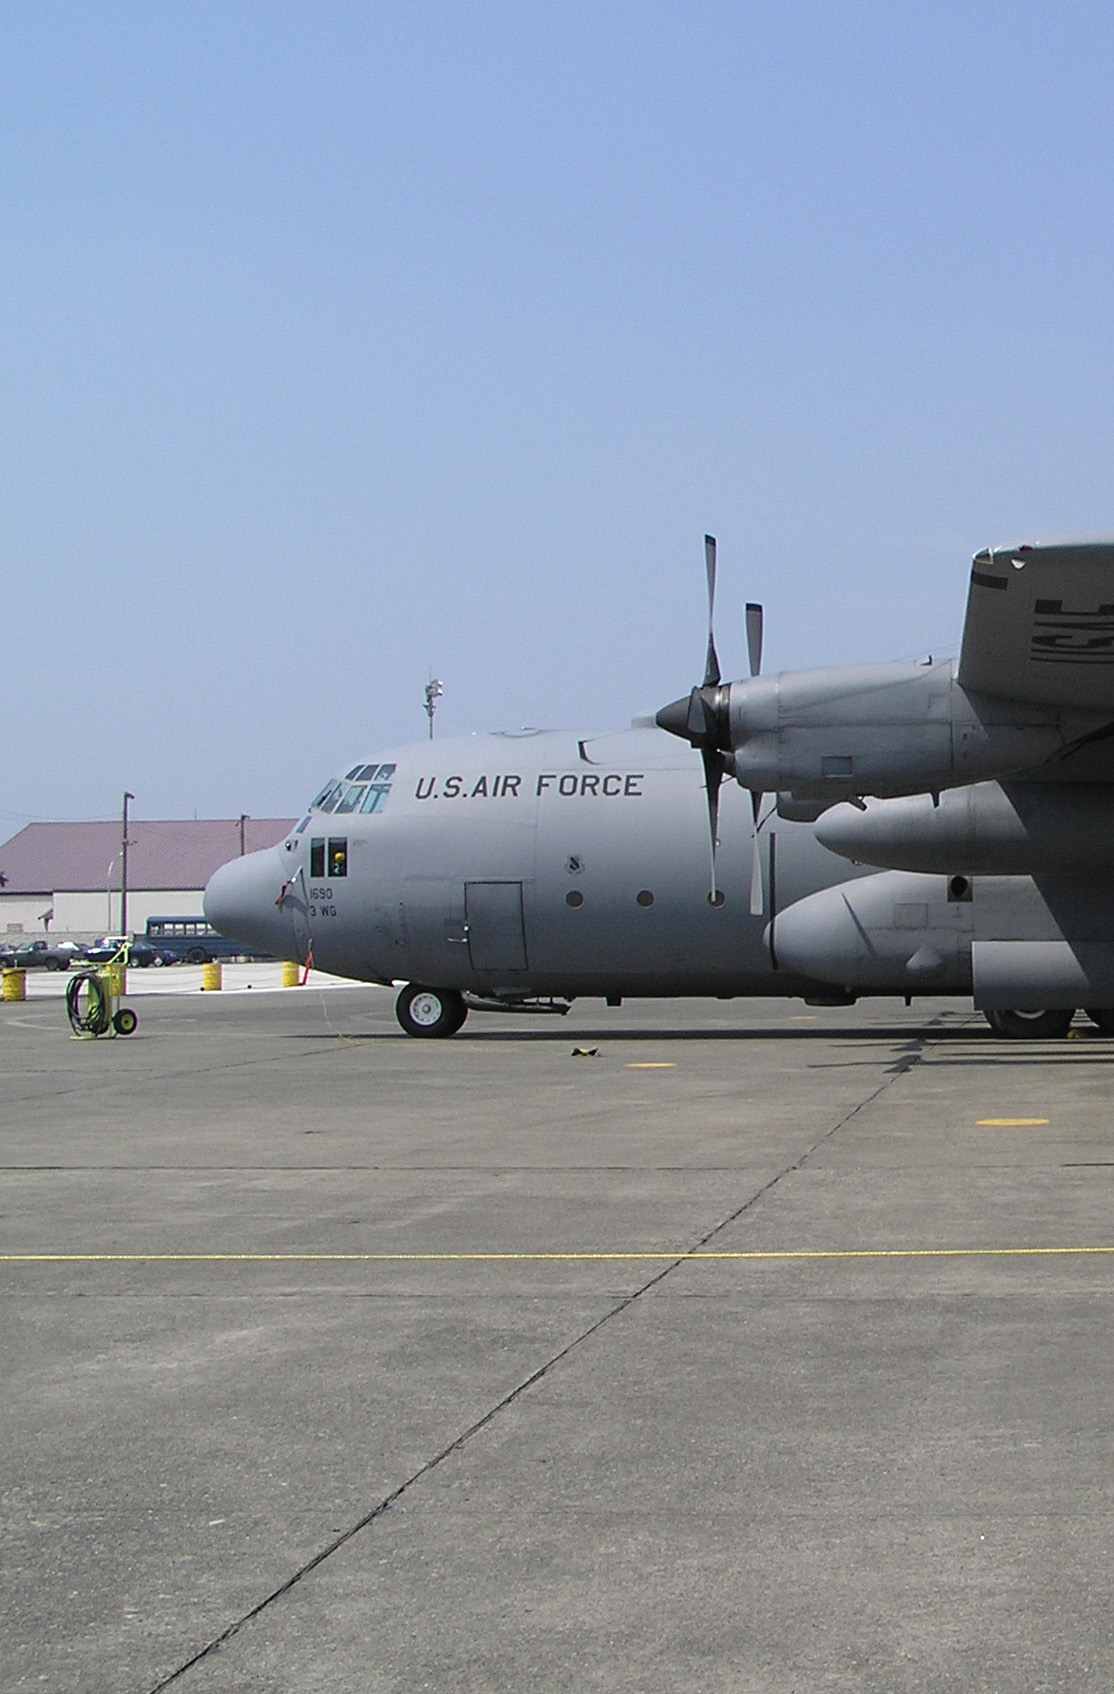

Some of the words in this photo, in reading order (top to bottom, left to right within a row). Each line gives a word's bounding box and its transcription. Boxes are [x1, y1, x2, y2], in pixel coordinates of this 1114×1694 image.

[536, 774, 645, 797] FORCE
[310, 887, 334, 900] 1690
[309, 905, 317, 917] 3
[320, 905, 338, 917] WG
